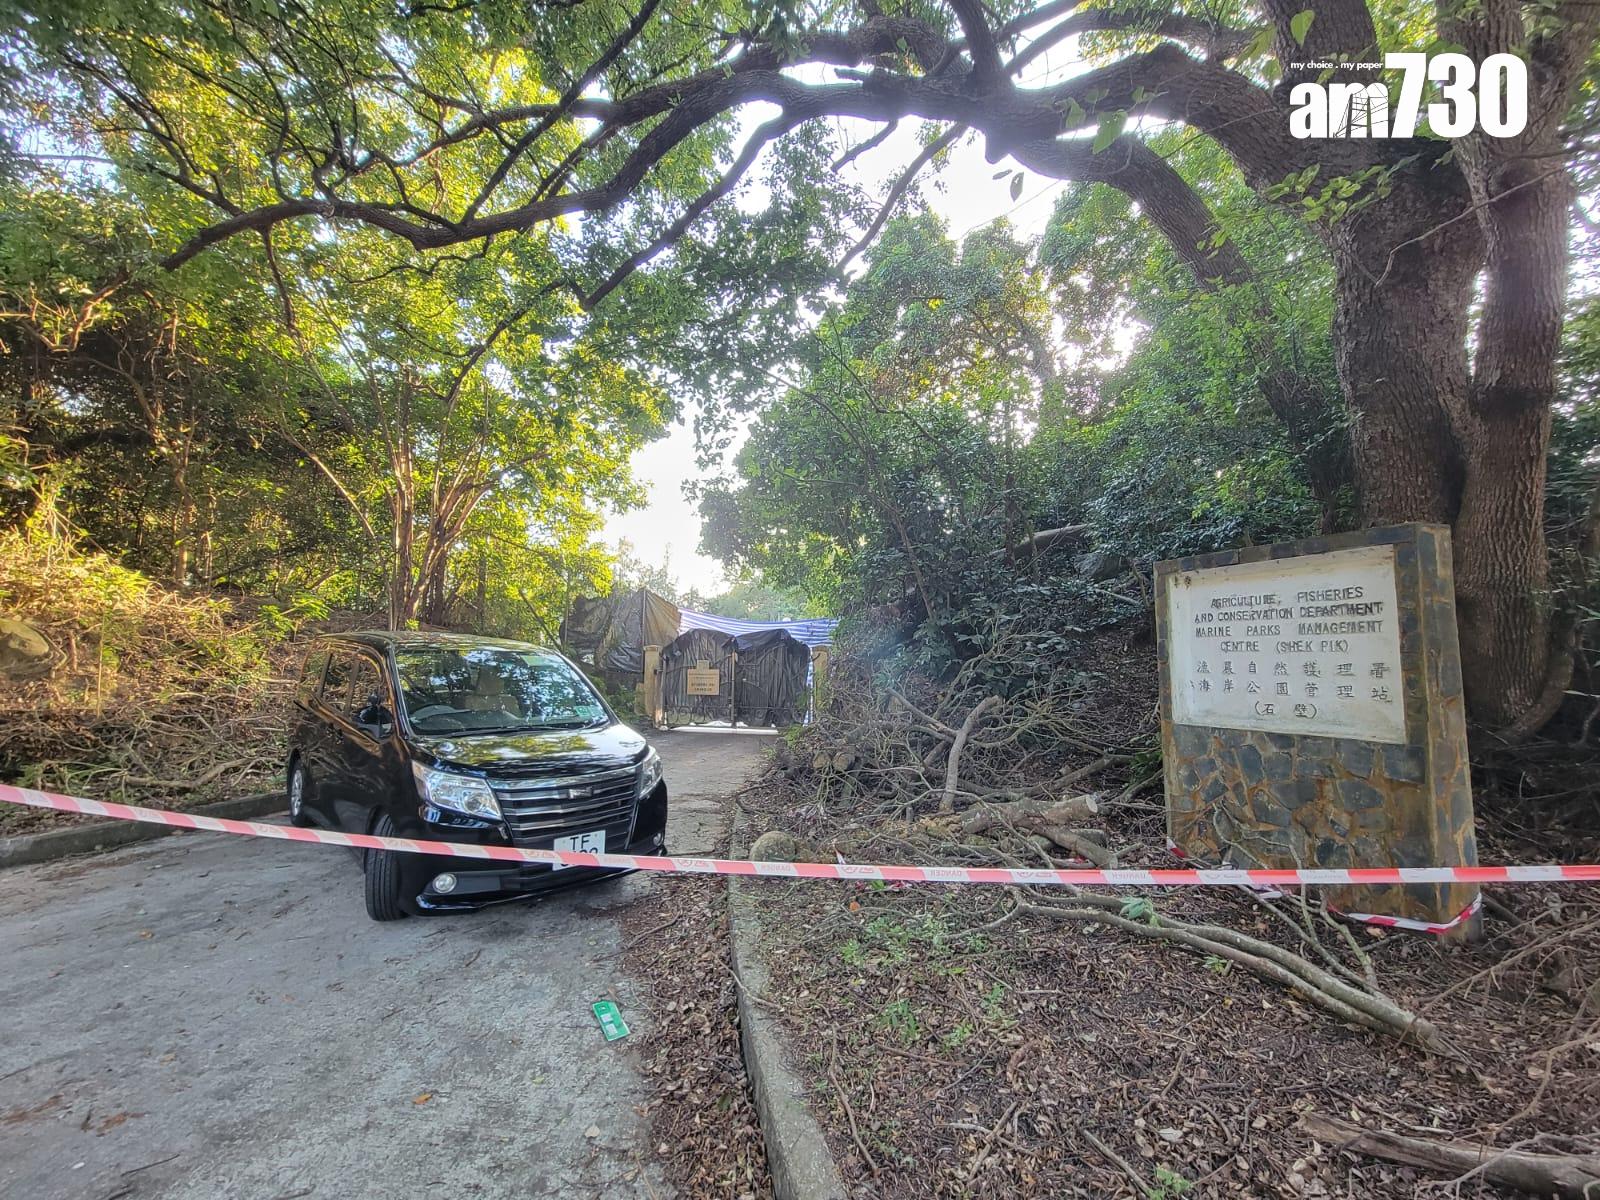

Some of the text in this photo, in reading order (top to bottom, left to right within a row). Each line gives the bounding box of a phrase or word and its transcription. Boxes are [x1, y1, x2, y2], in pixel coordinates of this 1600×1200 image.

[1297, 586, 1364, 602] FISHERIES
[1195, 612, 1214, 624] AND
[1217, 606, 1294, 621] CONSERVATION
[1195, 620, 1384, 638] MARINE PARKS MANAGEMENT
[1220, 639, 1349, 654] CENTRE (SHEK PIK)
[569, 834, 591, 850] TF
